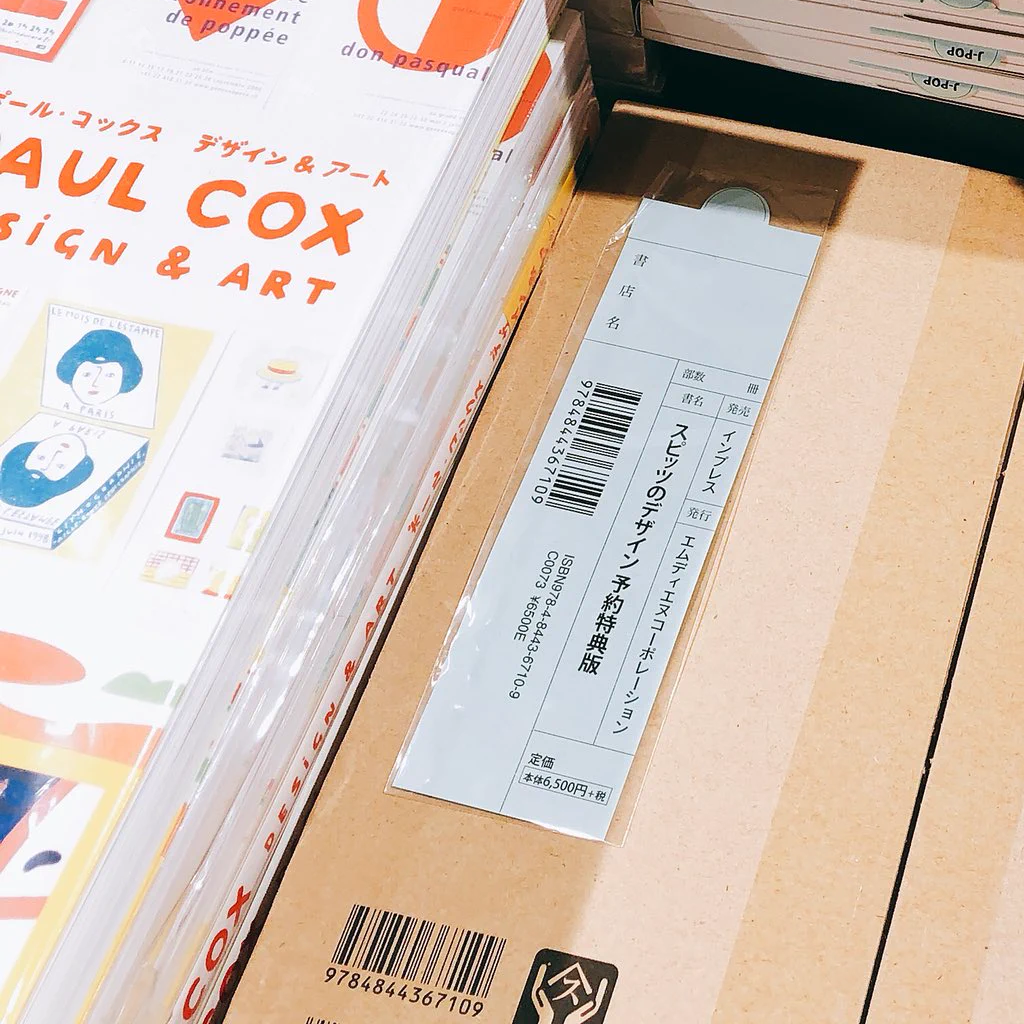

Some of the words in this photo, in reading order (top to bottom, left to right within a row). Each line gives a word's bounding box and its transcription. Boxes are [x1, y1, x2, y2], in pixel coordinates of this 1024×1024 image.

[166, 10, 193, 27] de
[200, 19, 289, 46] poppée
[341, 41, 385, 62] don
[947, 47, 985, 62] J-POP
[923, 76, 961, 92] J-POP
[0, 137, 146, 213] AUL
[186, 179, 365, 257] COX
[156, 245, 190, 280] &
[218, 262, 338, 306] ART
[682, 368, 706, 382] 部数
[681, 392, 704, 408] 書名
[726, 402, 751, 418] 発売
[531, 379, 594, 505] 9784844367109
[701, 430, 737, 494] インプレス
[686, 506, 712, 523] 発行
[535, 550, 559, 589] C0073
[508, 553, 575, 700] ISBN978-4-8443-6710-9
[577, 575, 632, 676] 予約特典版
[612, 535, 696, 735] エムディエヌコーポレーション
[527, 752, 556, 770] 定価
[183, 886, 250, 1021] COX
[364, 568, 397, 642] ART
[324, 966, 484, 1018] 9784844367109
